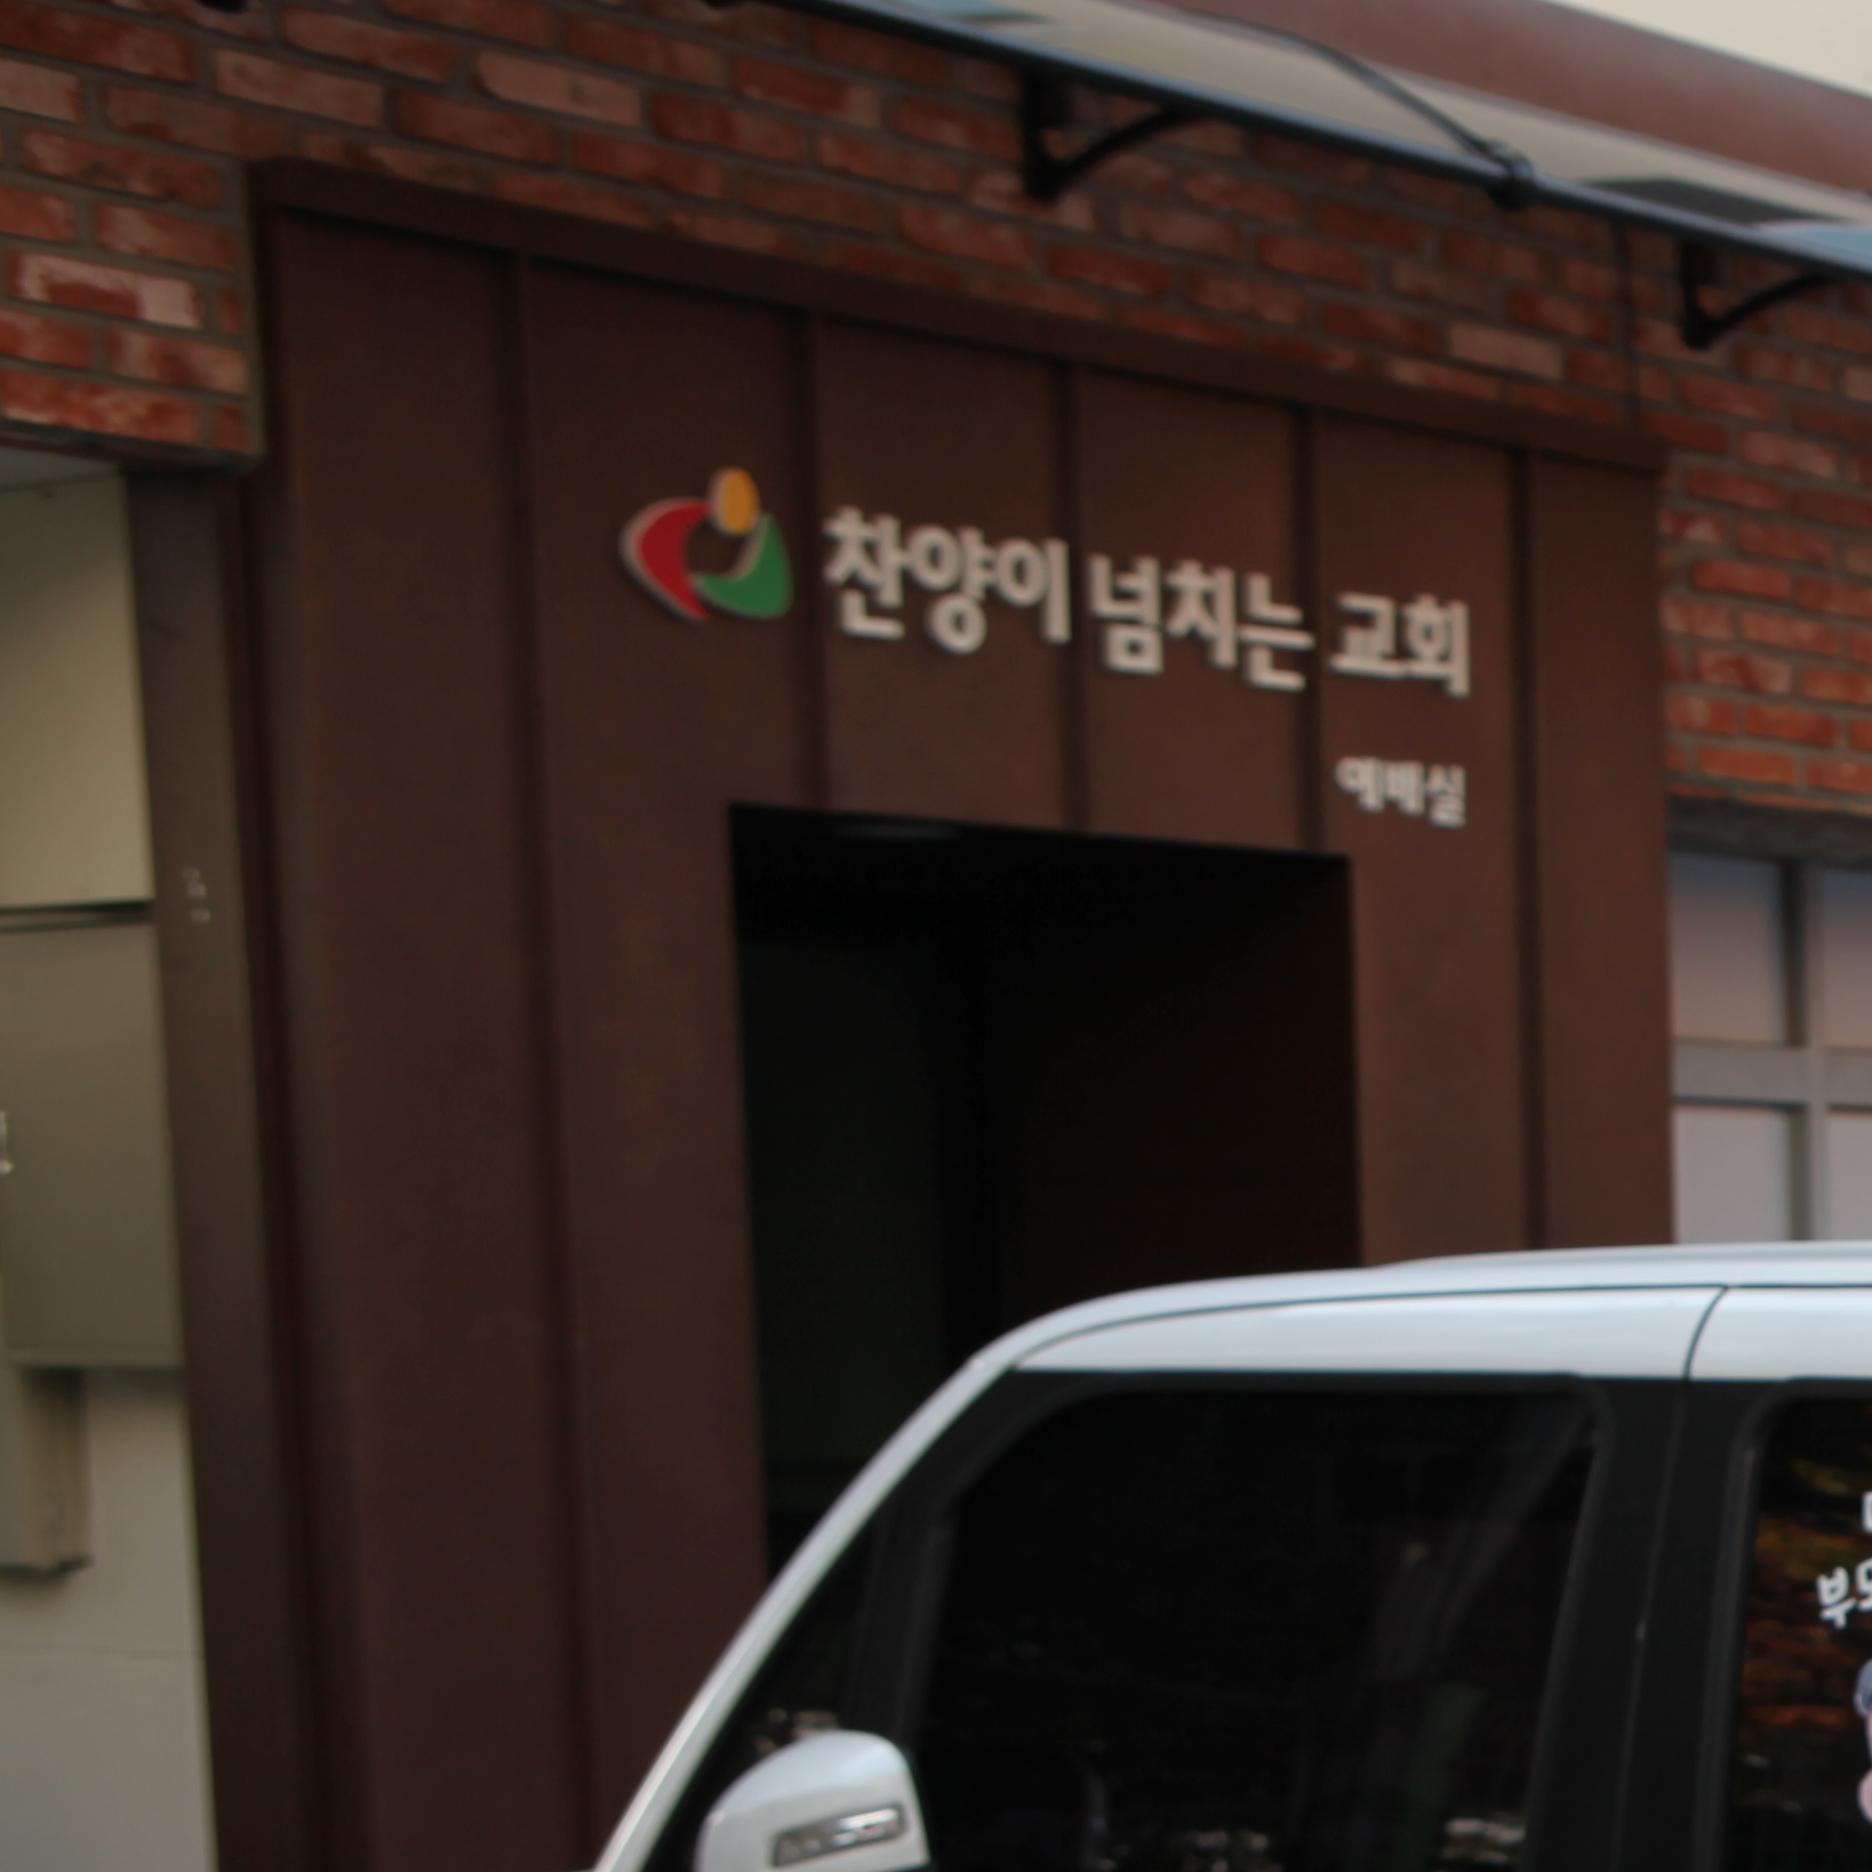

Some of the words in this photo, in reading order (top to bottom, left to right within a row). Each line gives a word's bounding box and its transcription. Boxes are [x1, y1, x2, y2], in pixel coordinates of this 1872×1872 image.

[825, 507, 1069, 654] 찬양이
[1089, 554, 1313, 691] 넘치는
[1331, 591, 1470, 697] 교회
[1337, 756, 1466, 827] 예배실
